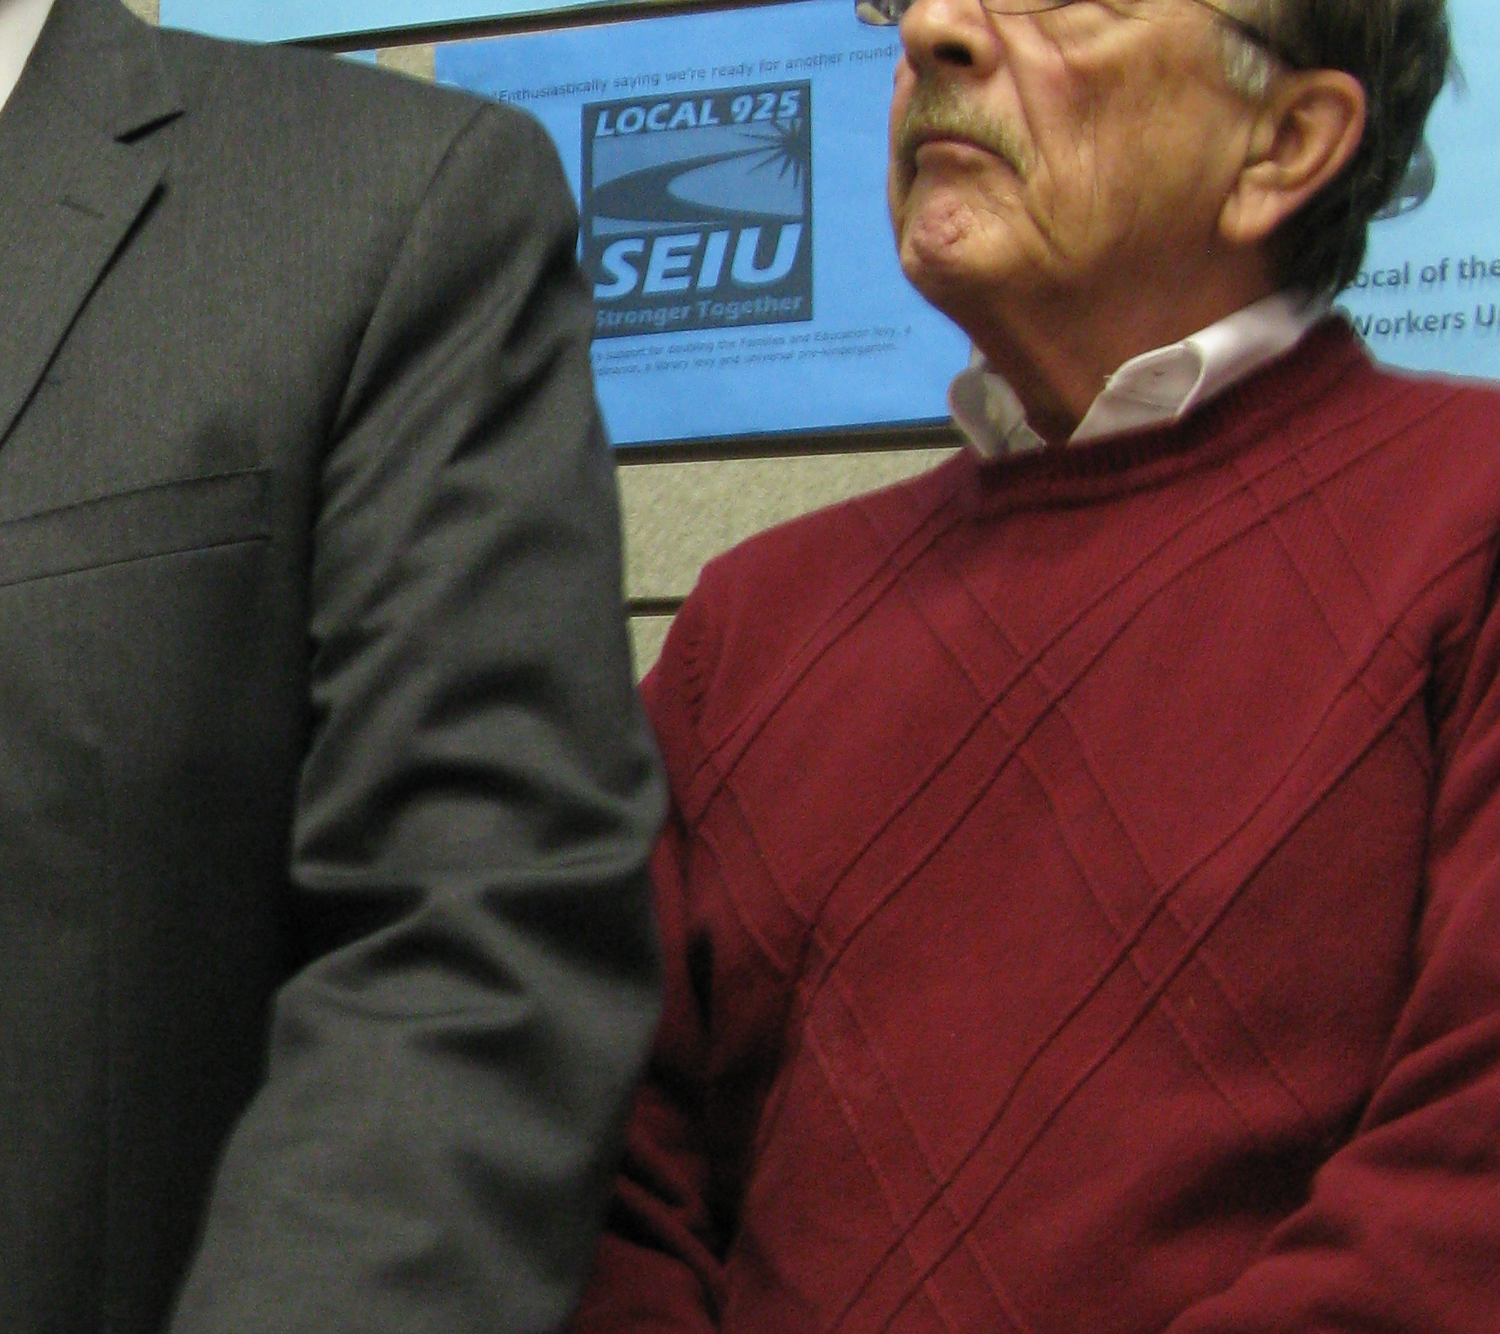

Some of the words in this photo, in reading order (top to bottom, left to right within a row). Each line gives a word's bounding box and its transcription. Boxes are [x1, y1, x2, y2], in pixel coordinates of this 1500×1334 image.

[612, 72, 661, 92] saying
[711, 61, 753, 81] ready
[758, 56, 780, 74] for
[785, 52, 844, 73] another
[595, 100, 724, 138] LOCAL
[730, 89, 801, 124] 925
[594, 221, 802, 299] SEIU
[1347, 261, 1411, 289] ocal
[1420, 256, 1449, 284] of
[596, 302, 692, 329] Stronger
[698, 295, 804, 321] Together
